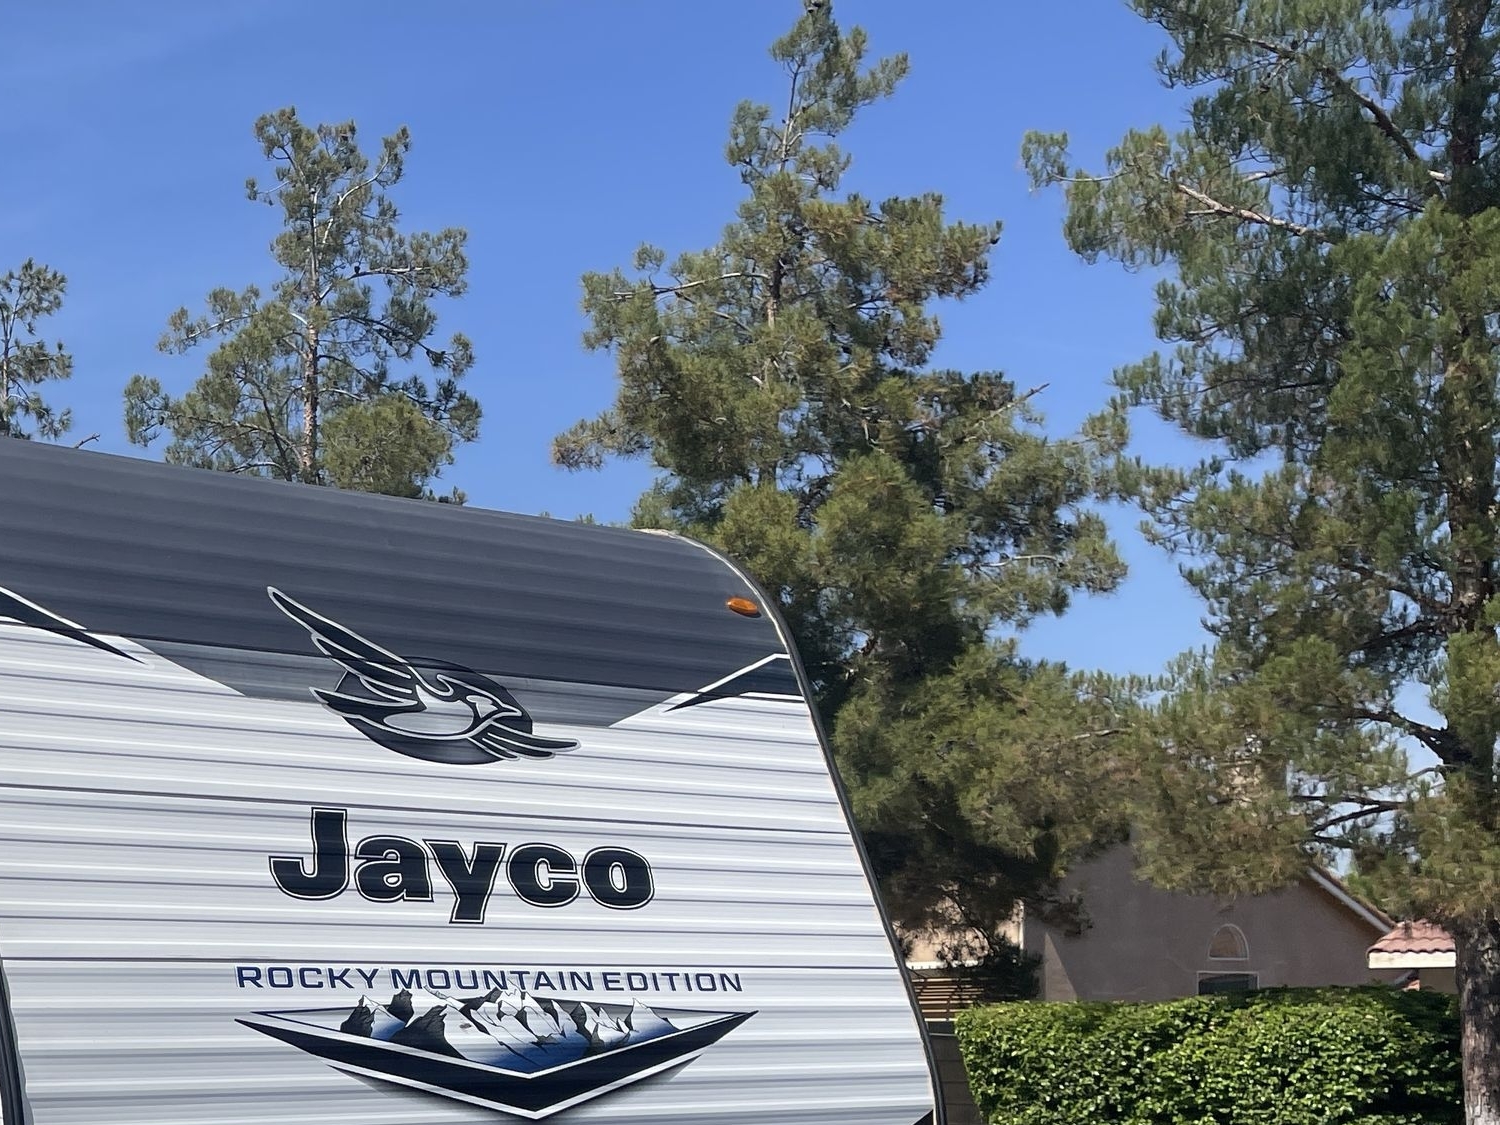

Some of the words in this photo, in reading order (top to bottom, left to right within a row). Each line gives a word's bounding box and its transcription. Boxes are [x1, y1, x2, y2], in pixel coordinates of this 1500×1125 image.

[268, 806, 655, 924] Jayco
[235, 966, 380, 989] ROCKY
[390, 968, 595, 991] MOUNTAIN
[601, 971, 743, 992] EDITION
